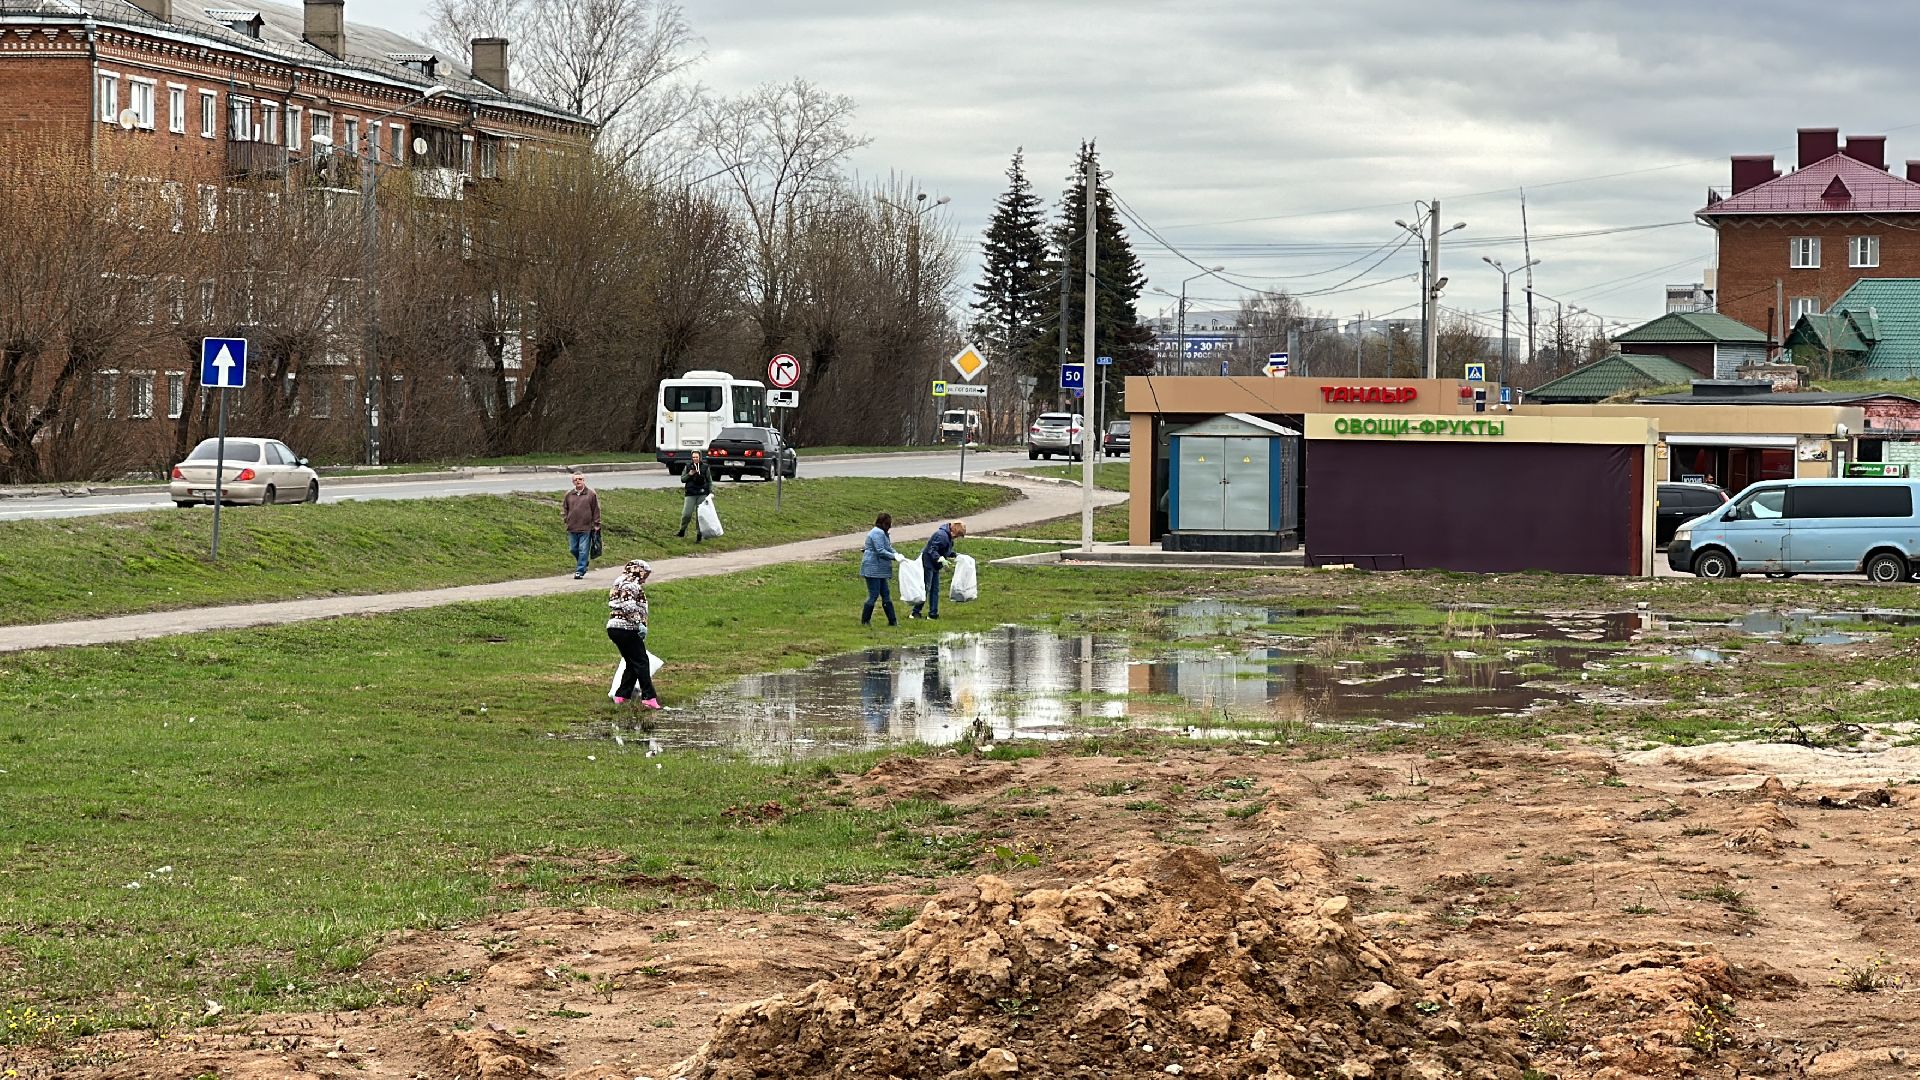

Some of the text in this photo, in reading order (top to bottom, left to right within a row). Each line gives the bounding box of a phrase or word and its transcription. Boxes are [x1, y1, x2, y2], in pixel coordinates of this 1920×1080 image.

[1200, 341, 1212, 351] 30
[1065, 371, 1081, 382] 50
[1320, 386, 1418, 404] ТАНДЫР
[1334, 417, 1505, 438] ОВОЩИ-ФРУКТЫ
